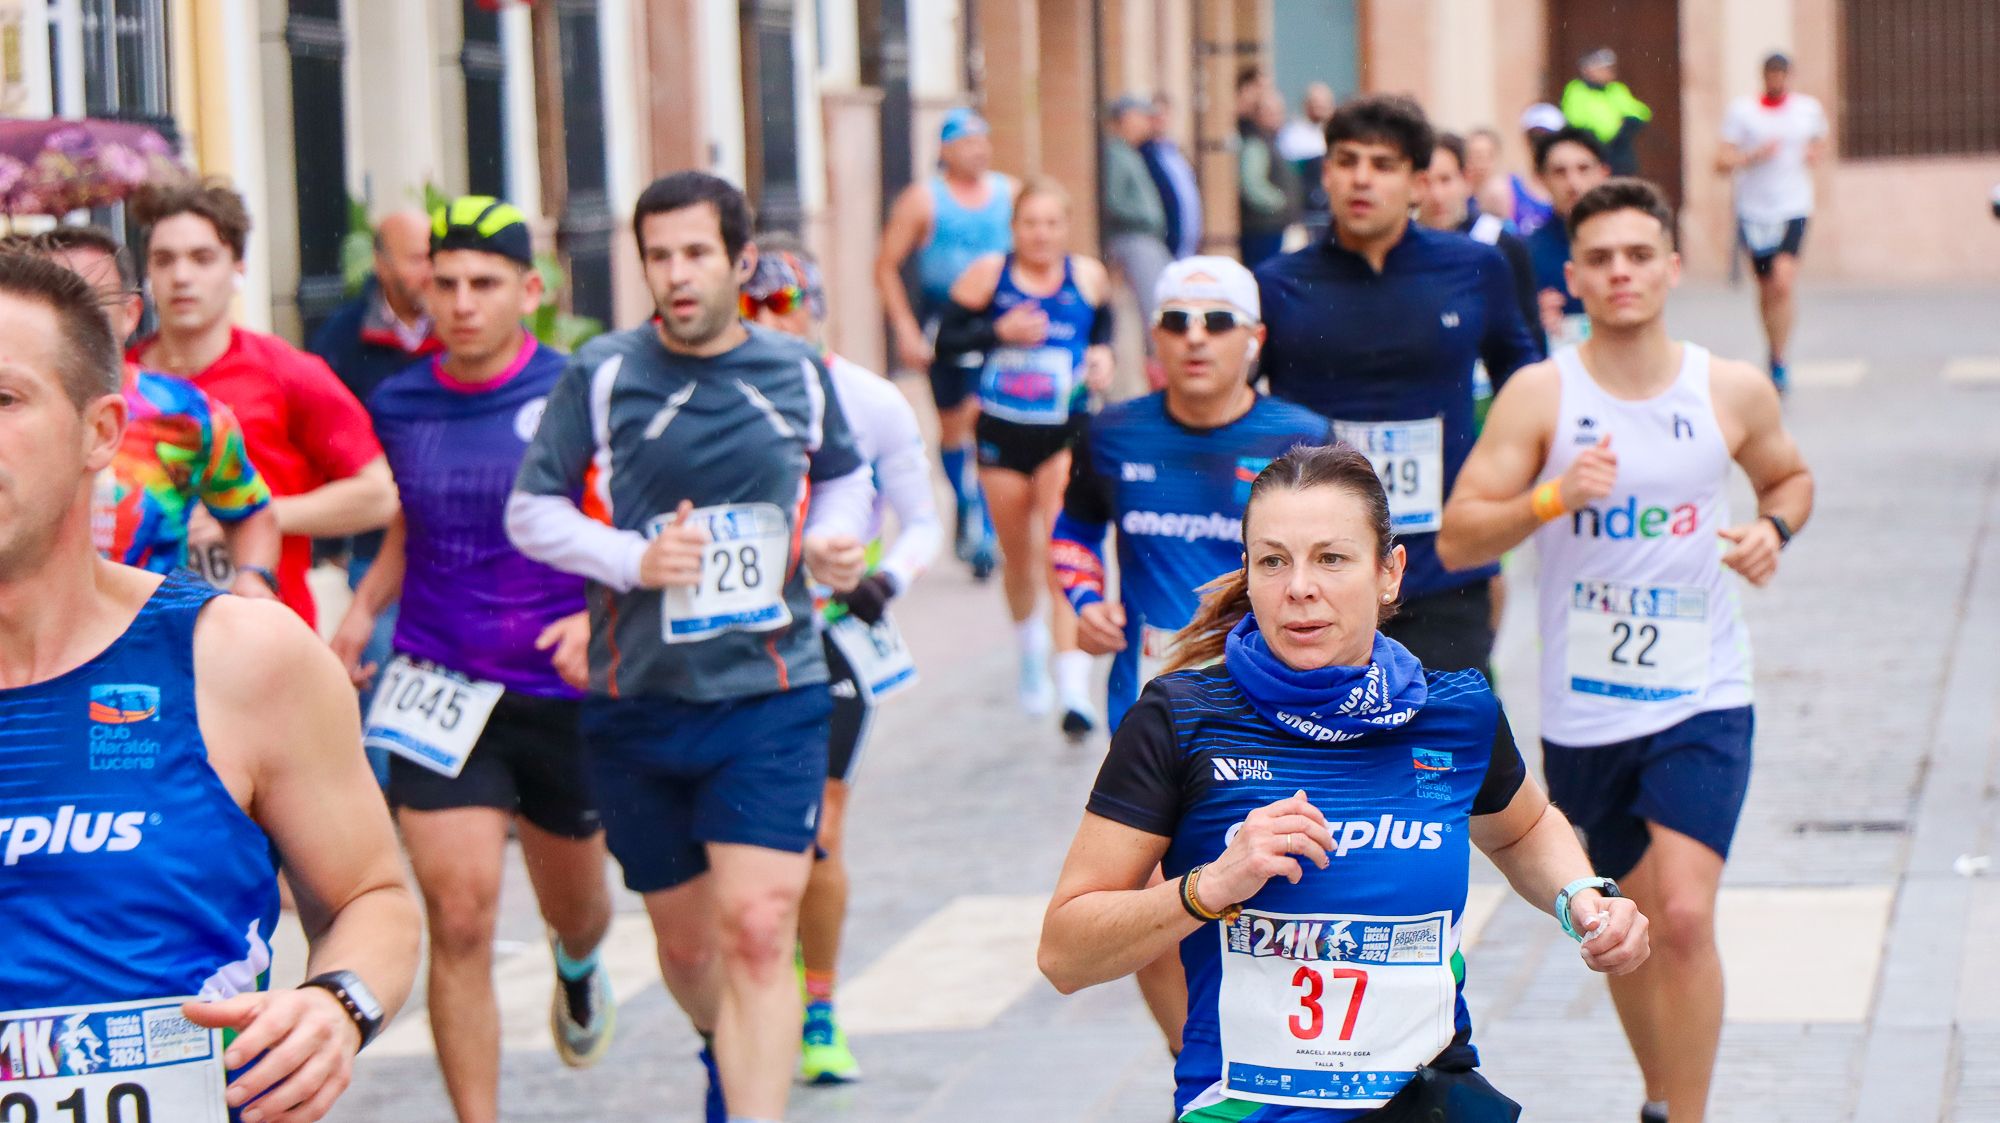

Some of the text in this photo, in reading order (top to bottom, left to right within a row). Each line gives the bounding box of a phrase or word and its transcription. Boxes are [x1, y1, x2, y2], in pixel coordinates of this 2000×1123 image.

[696, 546, 761, 597] 28
[1611, 622, 1658, 667] 22
[385, 672, 469, 731] 1045
[89, 725, 131, 740] Club
[89, 739, 160, 755] Maratón
[89, 756, 155, 770] Lucena
[1238, 759, 1268, 771] RUN
[1242, 769, 1273, 780] PRO
[1254, 919, 1322, 958] 21K
[1358, 950, 1387, 962] 2026
[1289, 966, 1368, 1041] 37
